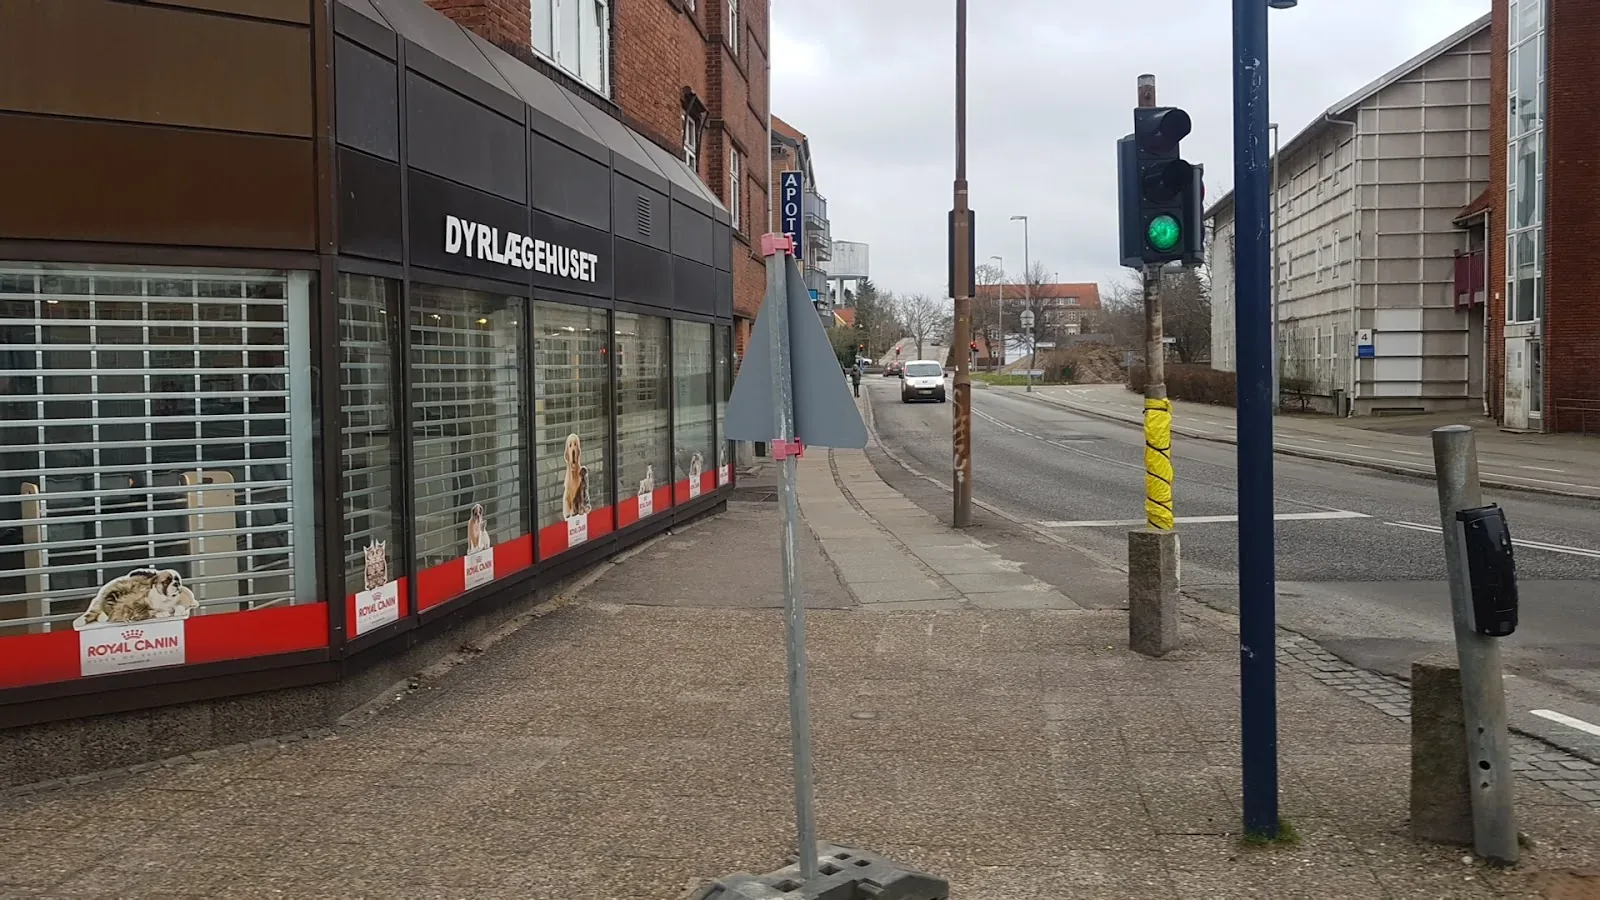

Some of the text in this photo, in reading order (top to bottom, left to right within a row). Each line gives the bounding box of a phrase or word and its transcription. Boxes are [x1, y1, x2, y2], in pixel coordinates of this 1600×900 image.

[785, 173, 798, 258] APOT
[445, 215, 598, 282] DYRLÆGEHUSET
[1361, 333, 1368, 341] 4
[88, 643, 131, 657] ROYAL
[134, 636, 178, 651] CANIN
